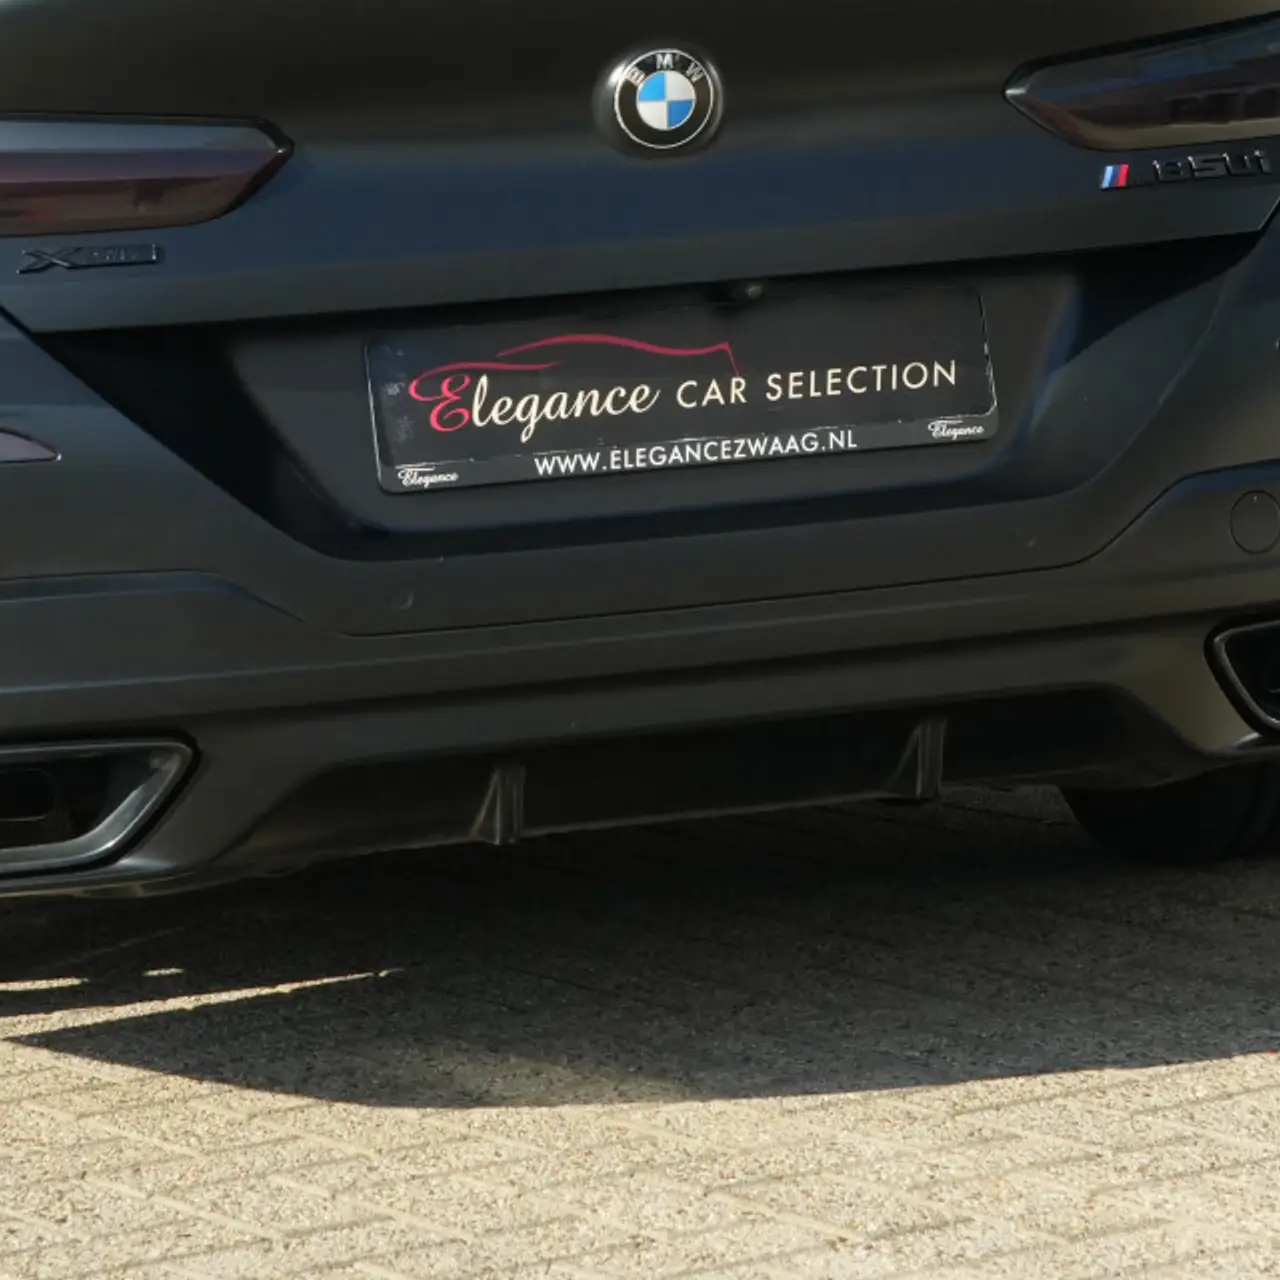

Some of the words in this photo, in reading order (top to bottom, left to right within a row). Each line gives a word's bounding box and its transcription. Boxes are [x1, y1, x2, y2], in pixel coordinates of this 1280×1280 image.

[622, 52, 705, 87] BMW
[407, 372, 661, 444] Elegance
[675, 375, 748, 409] CAR
[764, 359, 957, 402] SELECTION
[533, 429, 858, 477] WWW.ELEGANCEZWAAG.NL
